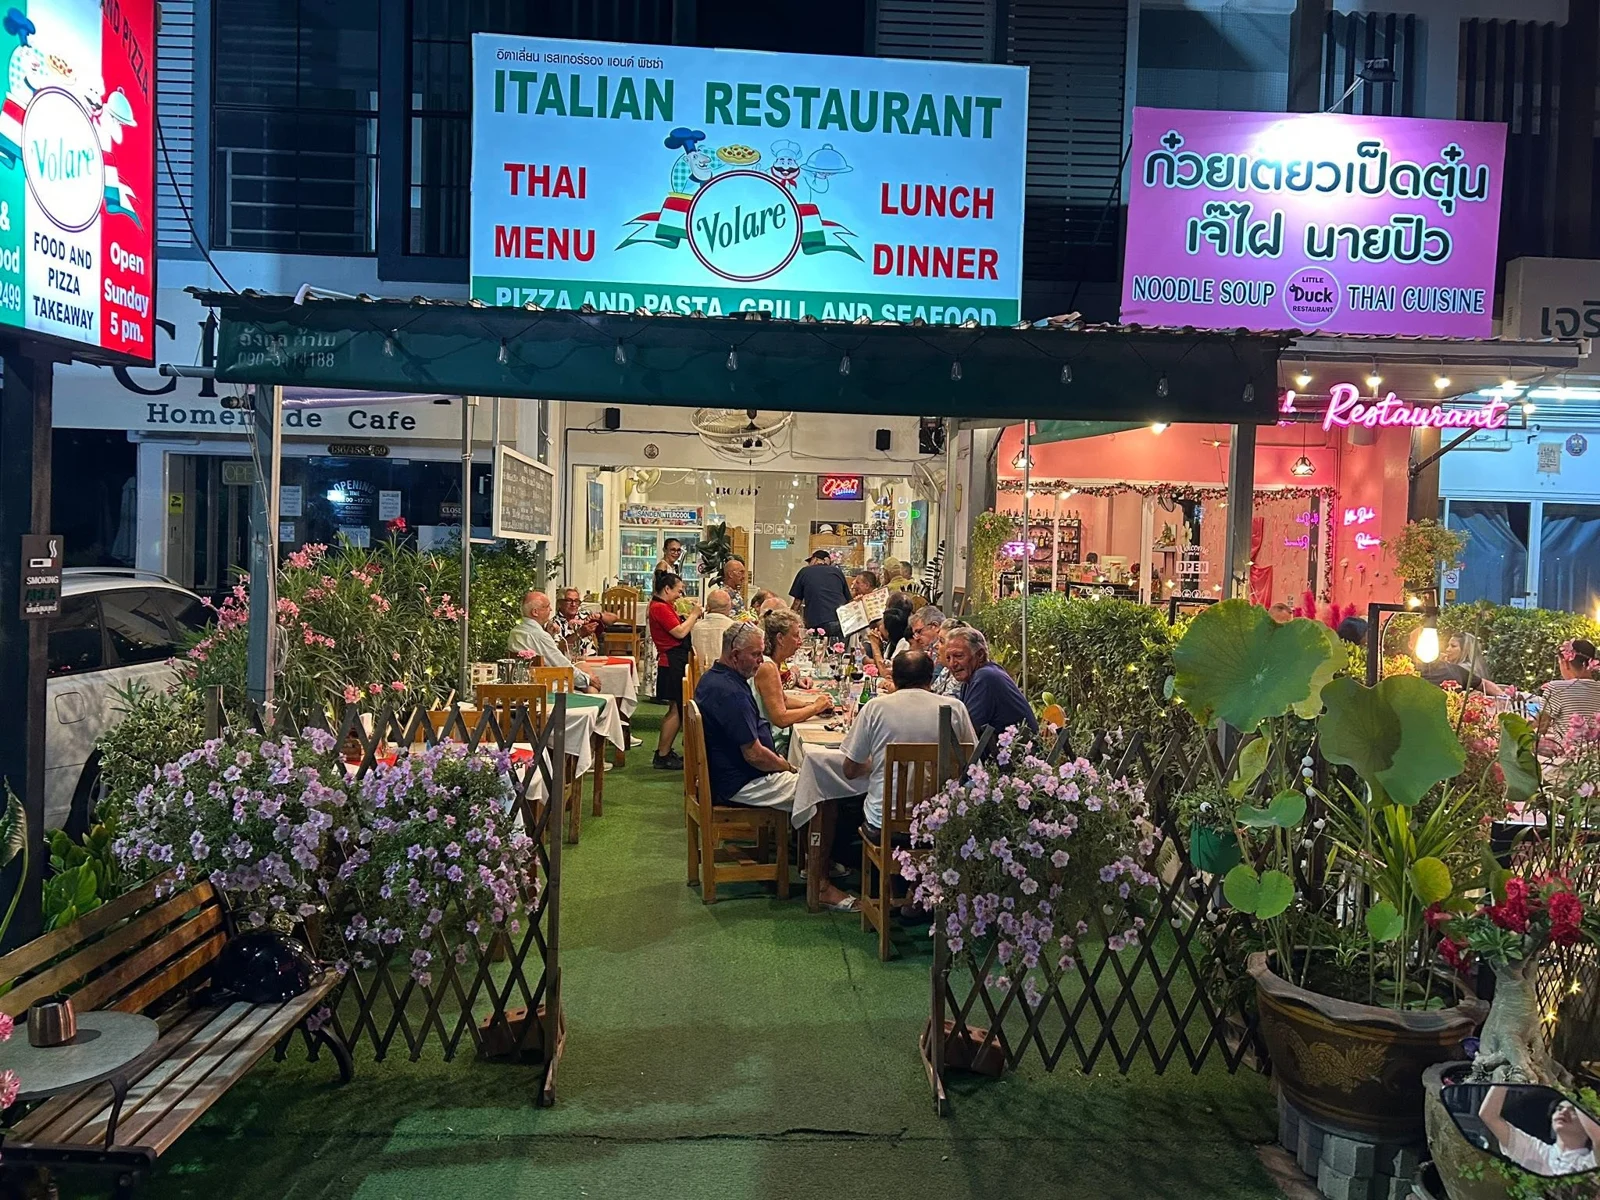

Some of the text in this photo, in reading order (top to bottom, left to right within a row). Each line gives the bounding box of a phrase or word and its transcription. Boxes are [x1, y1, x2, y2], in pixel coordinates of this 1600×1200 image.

[122, 15, 148, 105] PIZZA
[607, 55, 635, 68] แอนด์
[494, 69, 1002, 139] ITALIAN RESTAURANT
[31, 137, 95, 181] Volare
[494, 162, 596, 262] THAI MENU
[696, 203, 786, 254] Volare
[872, 181, 998, 281] LUNCH DINNER
[33, 232, 92, 270] FOOD AND
[110, 242, 145, 274] Open
[48, 267, 81, 296] PIZZA
[1133, 276, 1276, 307] NOODLE SOUP
[1290, 284, 1334, 303] Duck
[32, 295, 94, 330] TAKEAWAY
[104, 278, 149, 318] Sunday
[496, 287, 572, 311] PIZZA
[583, 291, 635, 313] AND
[643, 294, 722, 317] PASTA
[821, 301, 873, 322] AND
[881, 303, 997, 326] SEAFOOD
[1292, 305, 1334, 313] RESTAURANT
[1347, 286, 1485, 314] THAI CUISINE
[110, 311, 145, 343] 5 pm.
[347, 410, 417, 431] Cafe
[1322, 382, 1510, 432] Restaurant
[224, 465, 254, 481] OPE
[333, 479, 376, 494] OPENING
[822, 478, 859, 498] Open
[26, 575, 59, 585] SMOKING
[1178, 562, 1207, 572] OPEN
[812, 833, 820, 845] 7
